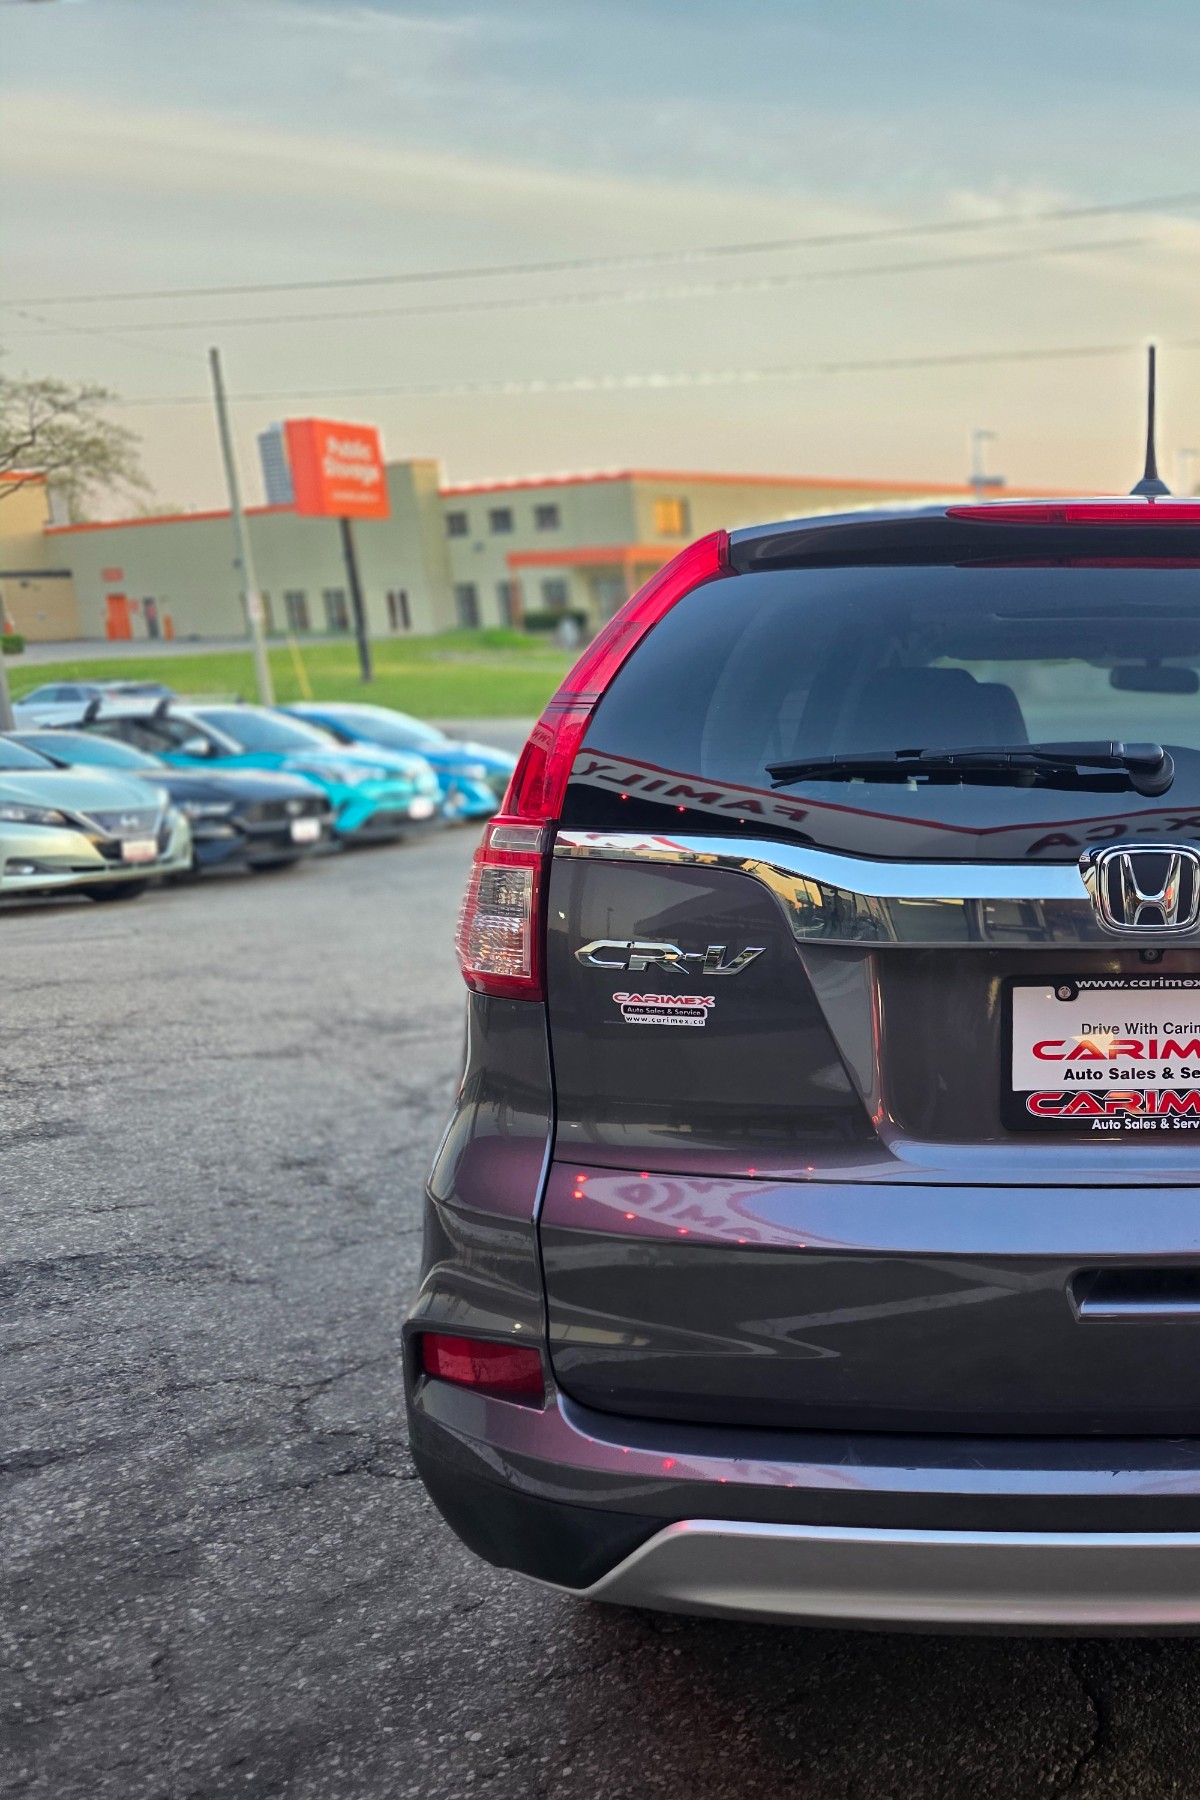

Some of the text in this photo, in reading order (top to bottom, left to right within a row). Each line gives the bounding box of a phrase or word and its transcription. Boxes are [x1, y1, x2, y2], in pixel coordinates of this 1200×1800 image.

[574, 939, 767, 976] CR-V
[613, 994, 714, 1006] CARIMEX
[675, 1008, 701, 1016] Service
[626, 1016, 704, 1026] www.carimex.ca
[1081, 1023, 1120, 1035] Drive
[1124, 1022, 1158, 1035] With
[1063, 1068, 1104, 1081] Auto
[1109, 1067, 1156, 1080] Sales
[1162, 1067, 1175, 1080] &
[1091, 1118, 1121, 1130] Auto
[1125, 1118, 1157, 1130] Sales
[1160, 1118, 1170, 1130] &
